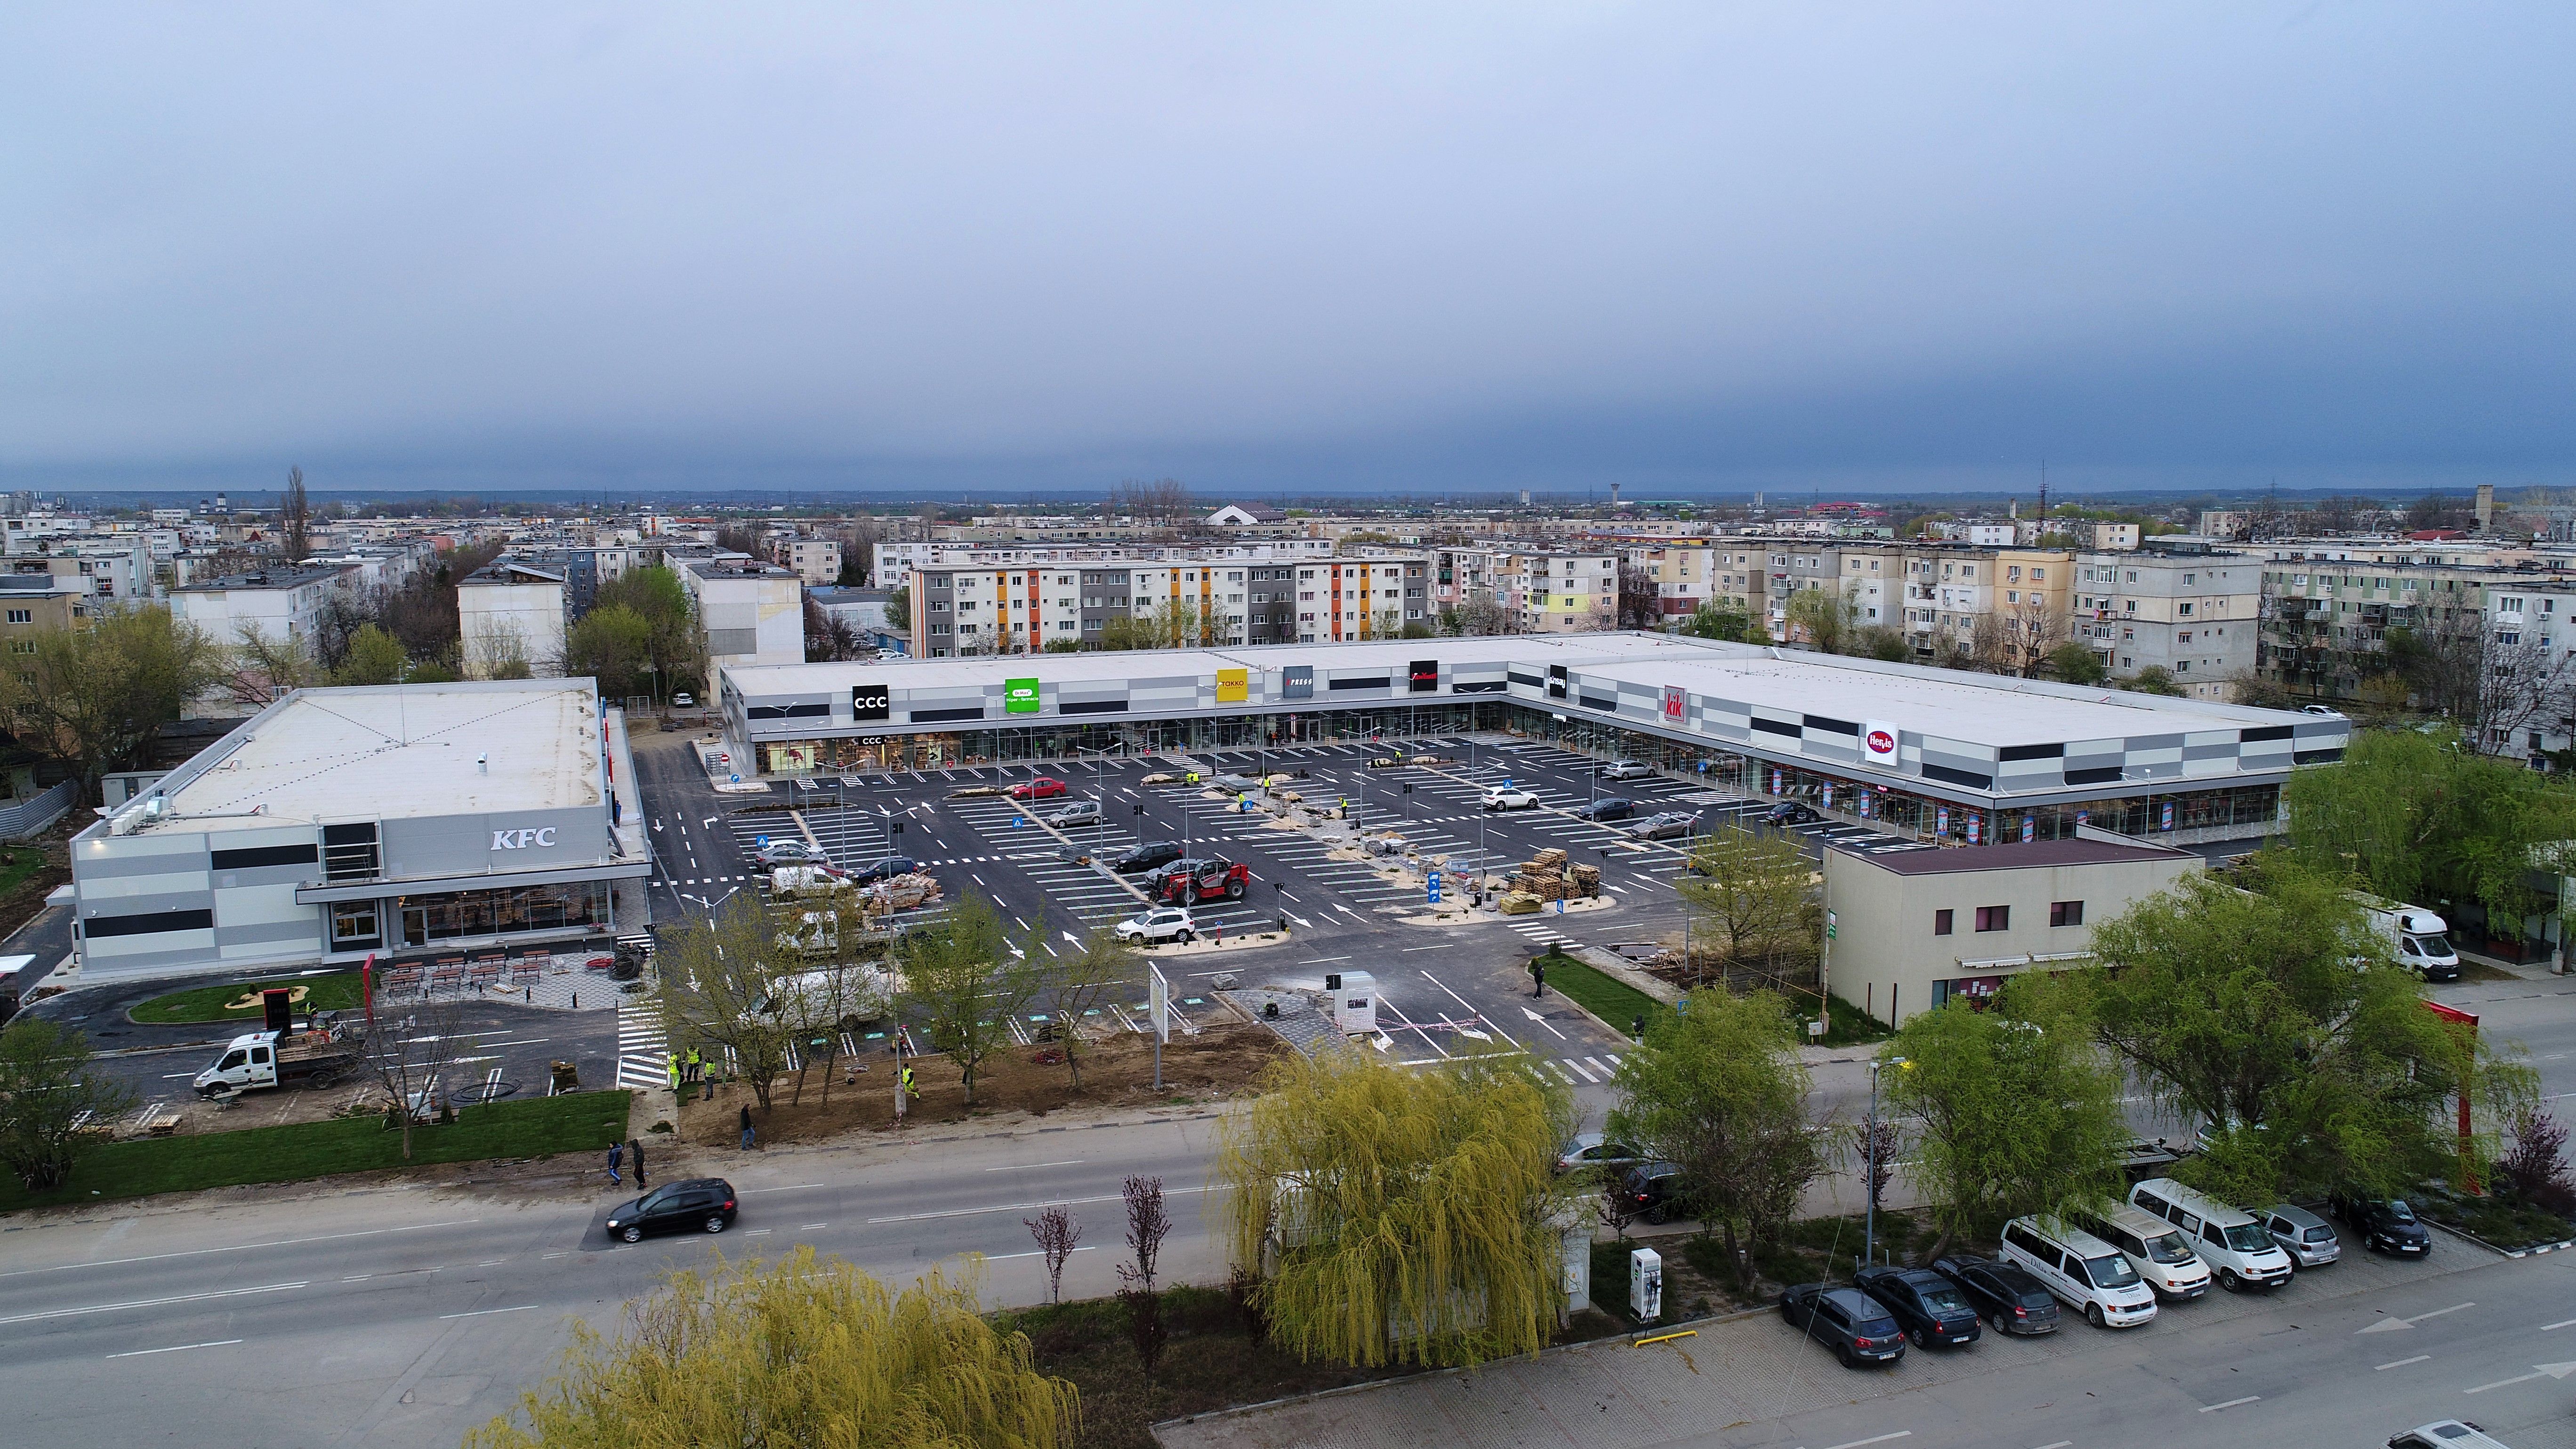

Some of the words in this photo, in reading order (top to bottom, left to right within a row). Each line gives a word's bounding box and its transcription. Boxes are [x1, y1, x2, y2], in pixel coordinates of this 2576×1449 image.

[1549, 676, 1566, 689] sinsay
[855, 696, 887, 709] CCC
[1869, 734, 1892, 749] Hervis
[491, 827, 556, 850] KFC
